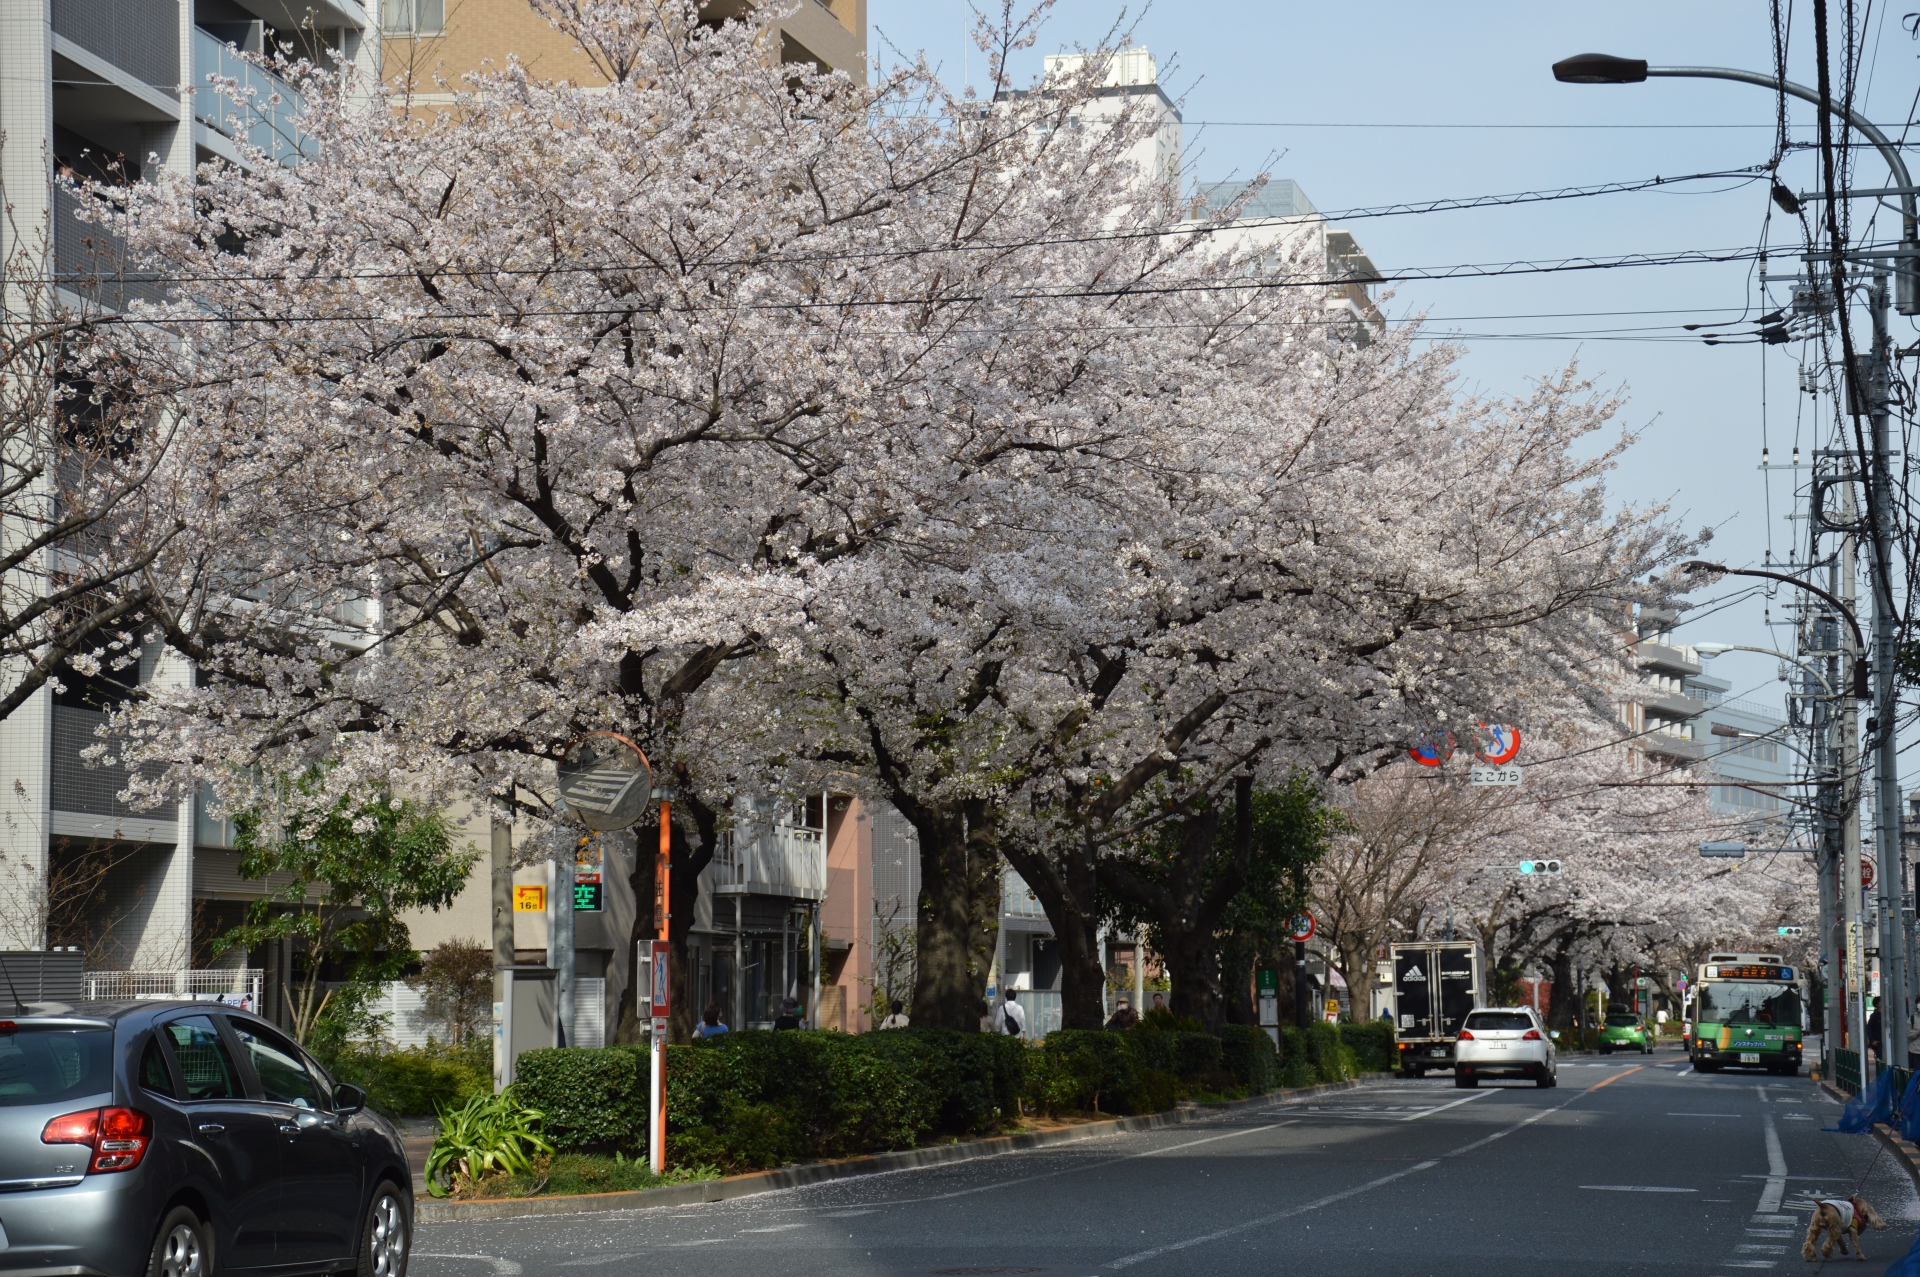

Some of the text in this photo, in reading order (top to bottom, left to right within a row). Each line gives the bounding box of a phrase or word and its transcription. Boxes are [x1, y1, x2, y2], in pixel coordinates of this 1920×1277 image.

[1474, 771, 1519, 782] ここから
[574, 884, 595, 909] 空
[1327, 1001, 1336, 1011] P
